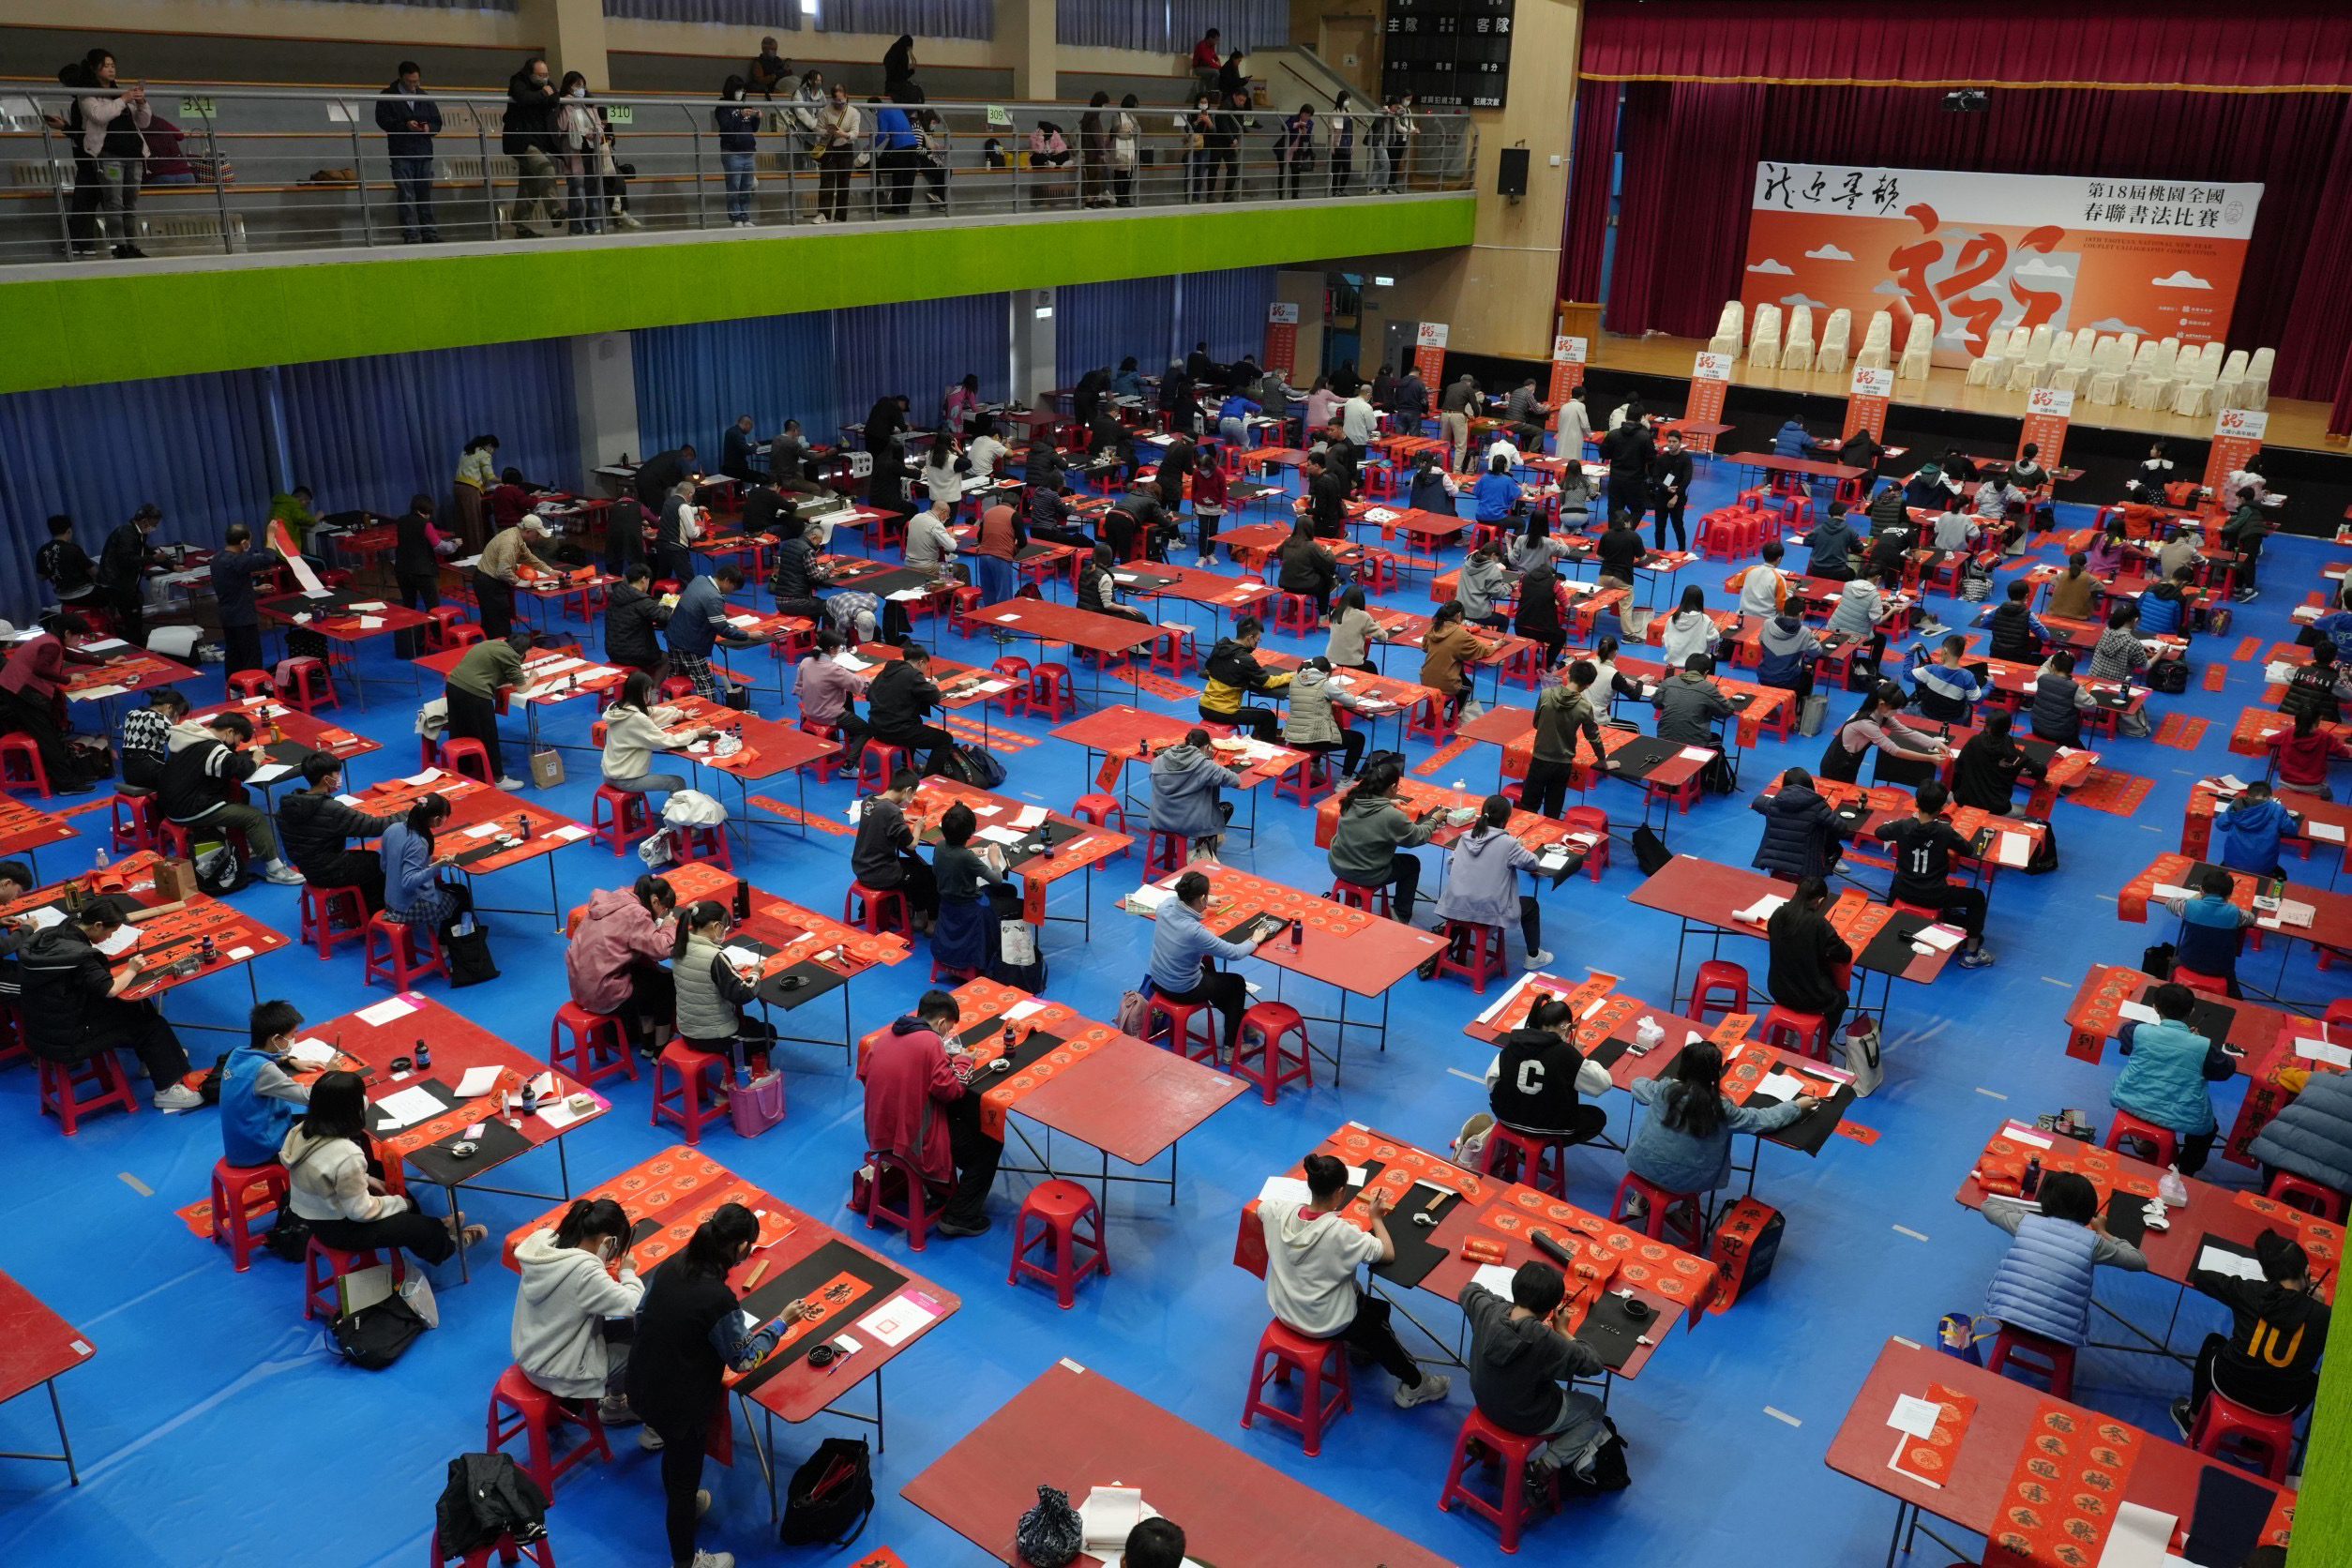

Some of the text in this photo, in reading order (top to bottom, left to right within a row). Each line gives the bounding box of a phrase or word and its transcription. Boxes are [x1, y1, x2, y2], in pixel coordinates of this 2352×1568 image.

[1388, 18, 1418, 32] 主隊
[1477, 18, 1510, 33] 客隊
[1392, 62, 1408, 70] 得分
[1481, 63, 1499, 72] 得分
[610, 105, 630, 118] 310
[989, 109, 1003, 120] 309
[2088, 182, 2225, 204] 第18屆桃園全國
[2084, 203, 2221, 229] 春聯書法比賽
[1911, 848, 1929, 874] 11
[1516, 1060, 1545, 1095] C
